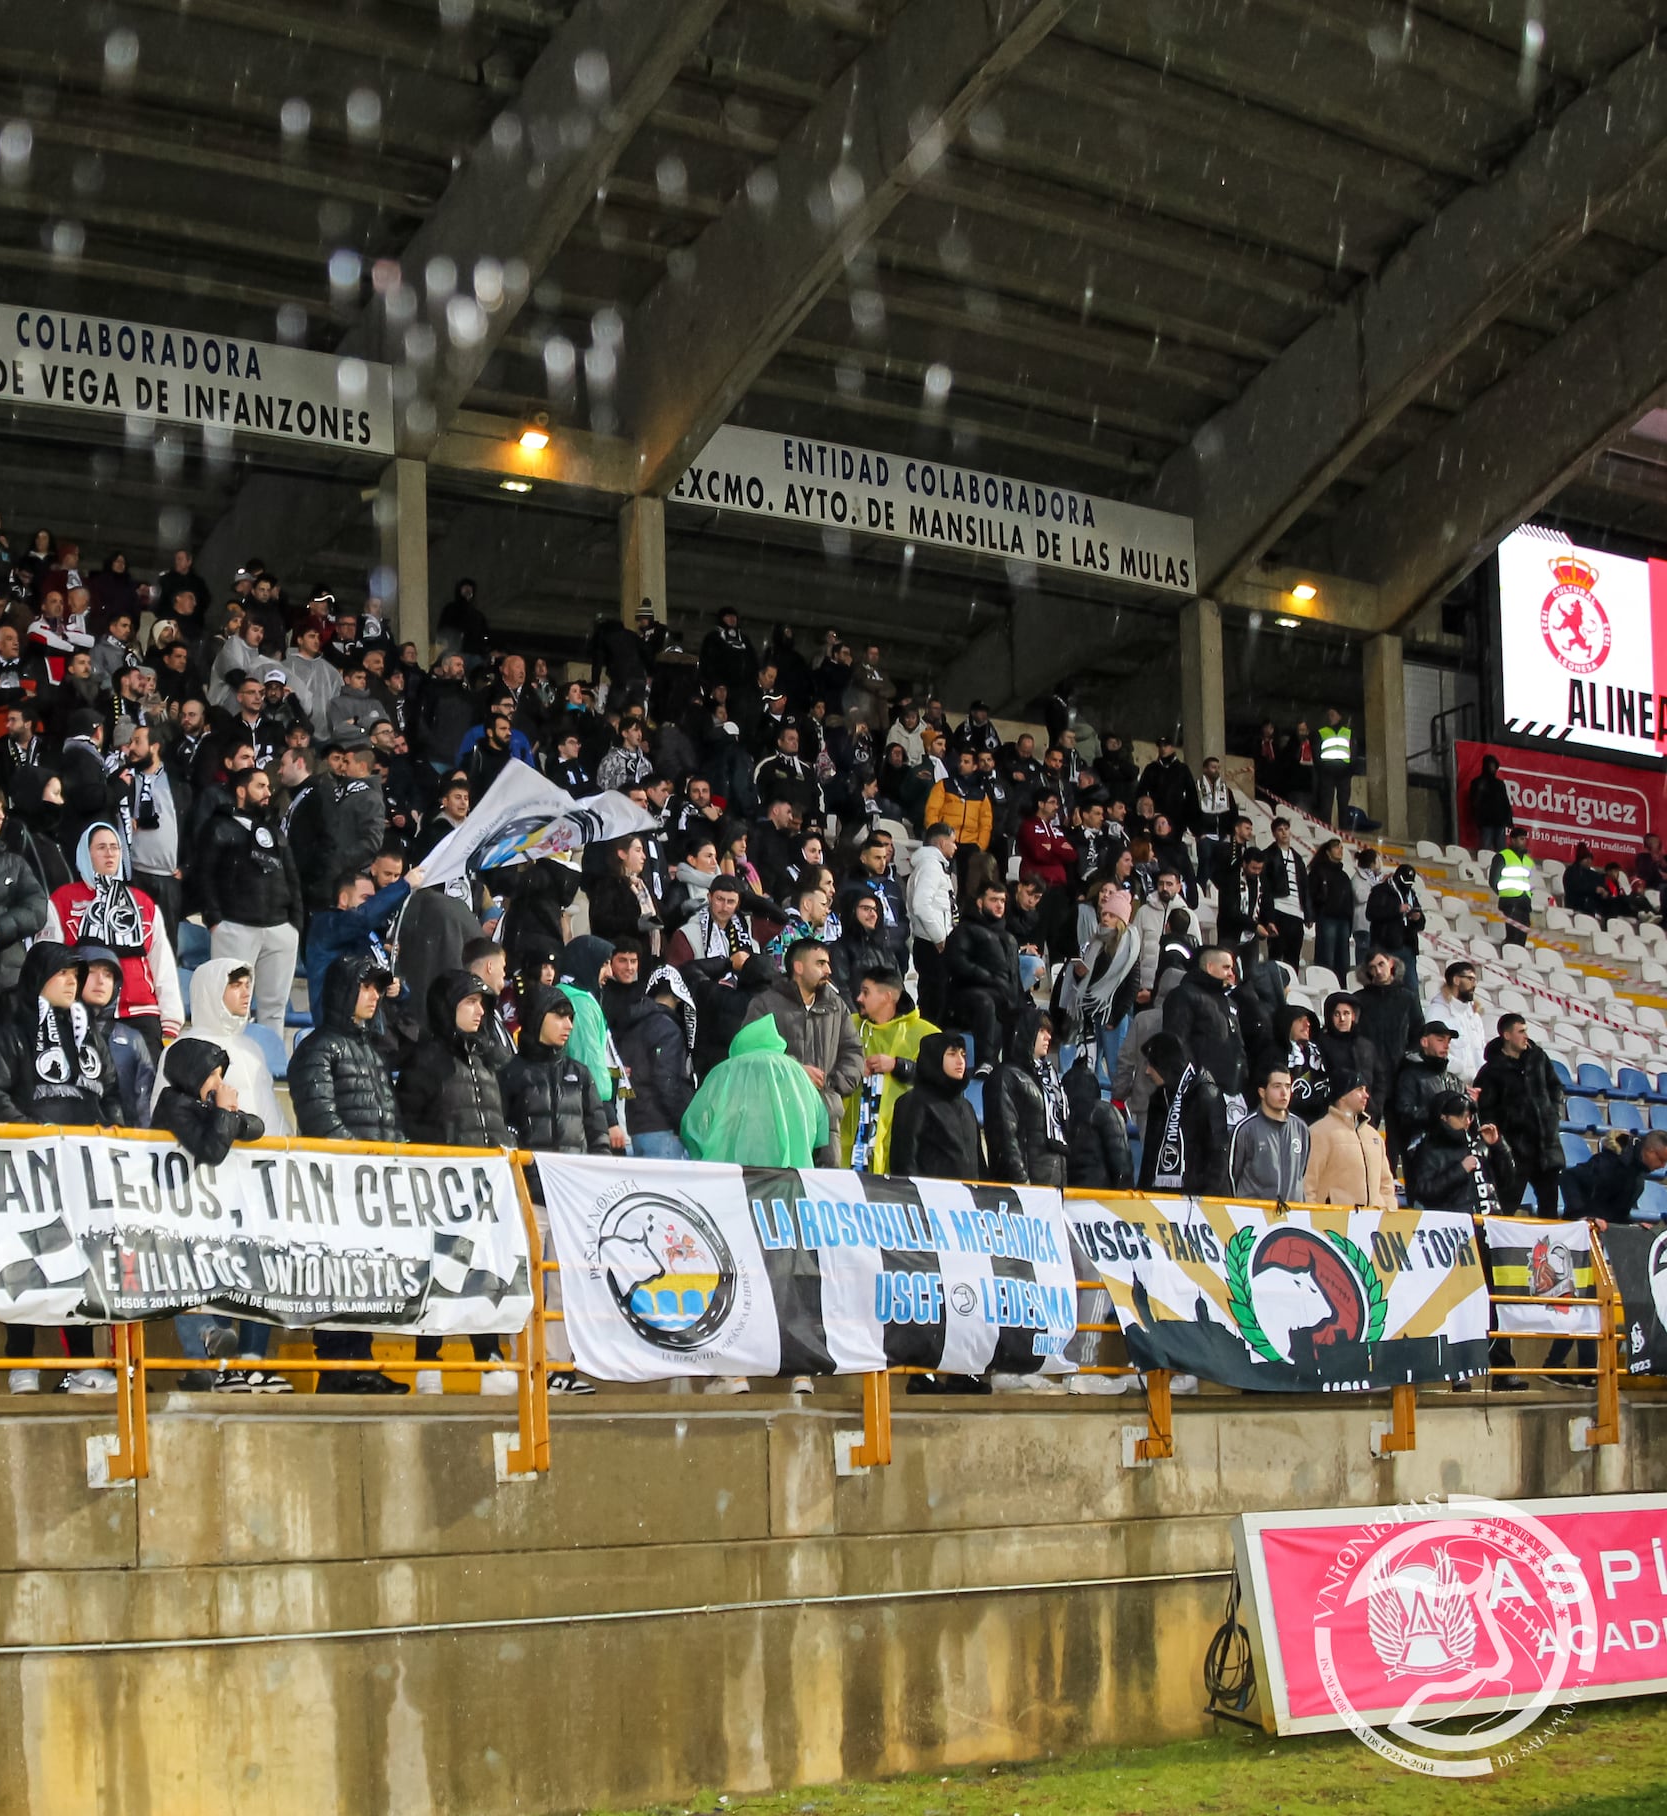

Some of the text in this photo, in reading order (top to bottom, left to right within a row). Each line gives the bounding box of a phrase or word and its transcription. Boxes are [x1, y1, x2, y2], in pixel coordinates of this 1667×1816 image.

[16, 311, 262, 382] COLABORADORA
[40, 364, 121, 408] VEGA
[136, 378, 169, 415] DE
[184, 385, 372, 447] INFANZONES
[784, 439, 1095, 529] ENTIDAD COLABORADORA
[673, 466, 1191, 589] EXCMO. AYTO. DE MANSILLA DE LAS MULAS
[1504, 780, 1637, 825] Rodríguez
[250, 1159, 340, 1227] TAN
[354, 1163, 500, 1227] CERCA
[752, 1198, 798, 1251] LA
[798, 1198, 951, 1254] ROSQUILLA
[951, 1201, 1063, 1266] MECÁNICA
[1157, 1220, 1220, 1263] FANS
[1370, 1231, 1407, 1272] ON
[102, 1250, 422, 1299] EXILIADOS UNIONISTAS
[875, 1271, 1076, 1331] USCF LEDESMA
[114, 1297, 147, 1310] DESDE
[316, 1301, 330, 1314] DE
[333, 1301, 393, 1314] SALAMANCA
[394, 1301, 406, 1314] CF
[1630, 1359, 1652, 1374] 1923
[1535, 1618, 1667, 1660] ACAD
